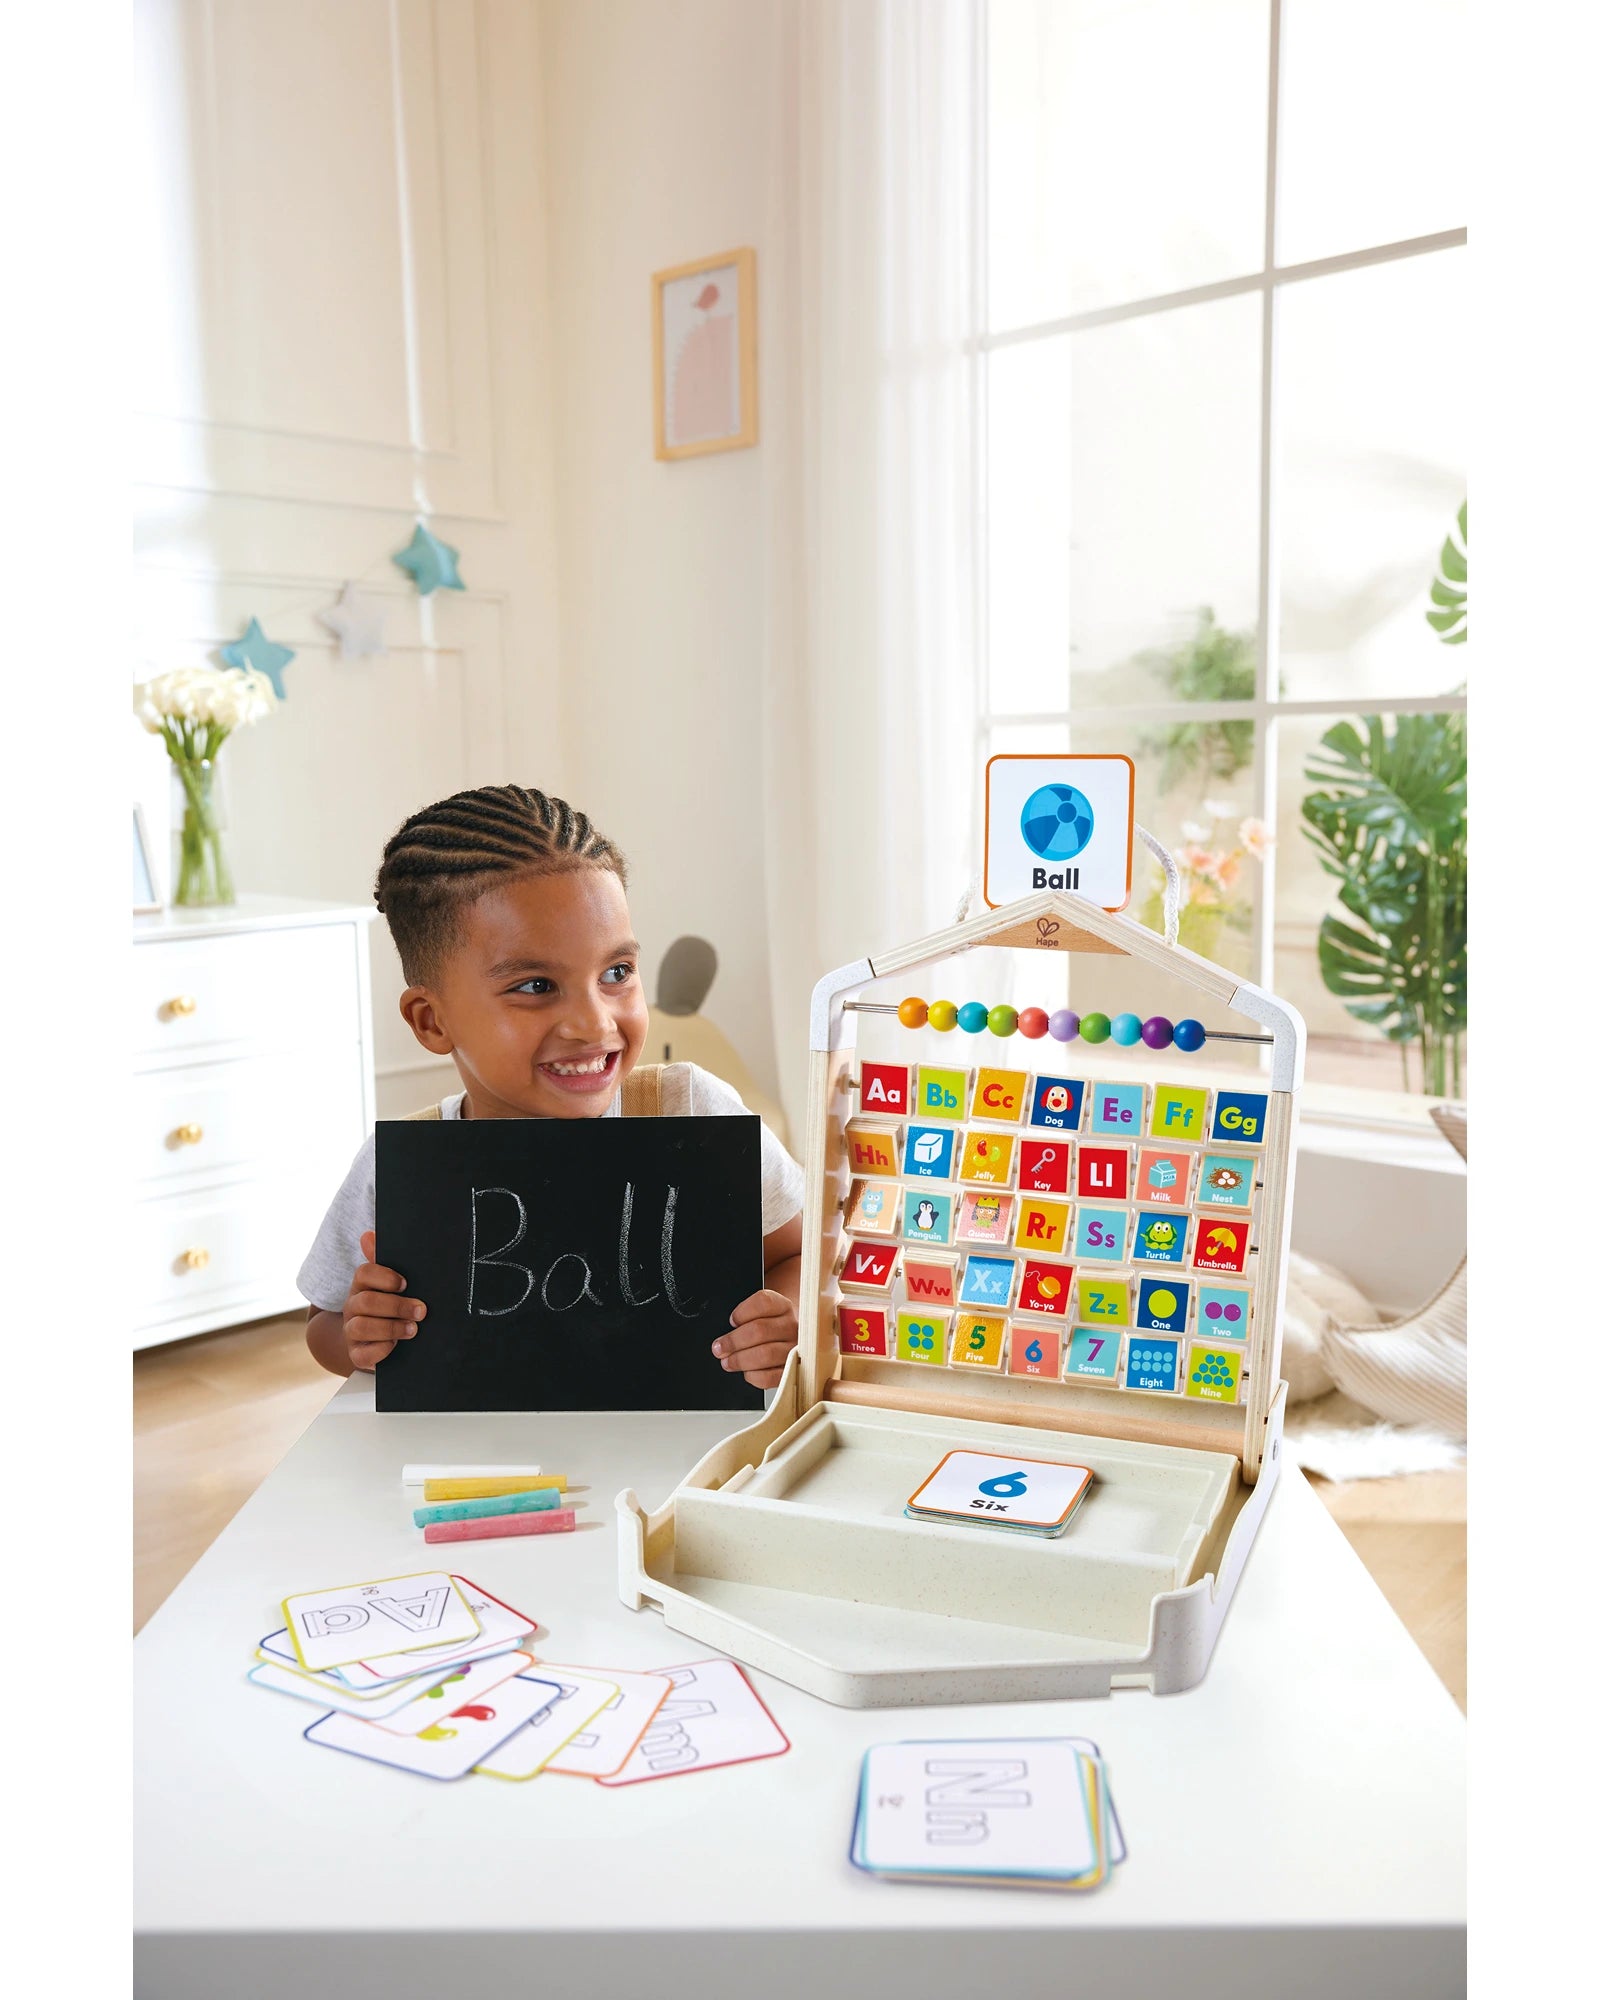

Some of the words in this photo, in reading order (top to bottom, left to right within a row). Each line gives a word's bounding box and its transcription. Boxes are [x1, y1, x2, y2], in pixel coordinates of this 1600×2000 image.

[1032, 868, 1079, 890] Ball
[1036, 938, 1059, 947] Hape
[867, 1078, 900, 1103] Aa
[926, 1082, 957, 1108] Bb
[982, 1083, 1014, 1109] Cc
[1103, 1097, 1133, 1123] Ee
[1164, 1101, 1194, 1127] Ff
[1045, 1116, 1064, 1127] Dog
[1219, 1106, 1257, 1136] Gg
[855, 1144, 888, 1166] Hh
[919, 1167, 932, 1176] Ice
[973, 1170, 995, 1182] Jelly
[1034, 1181, 1051, 1191] Key
[1150, 1191, 1171, 1202] Milk
[1212, 1193, 1233, 1204] Nest
[1026, 1211, 1057, 1239] Rr
[908, 1229, 942, 1241] Penguin
[967, 1229, 996, 1240] Queen
[1087, 1221, 1115, 1248] Ss
[467, 1181, 704, 1318] Ball
[1145, 1250, 1171, 1260] Turtle
[855, 1253, 885, 1276] Vv
[1197, 1258, 1237, 1271] Umbrella
[908, 1276, 951, 1297] Ww
[970, 1269, 1003, 1294] Xx
[1029, 1299, 1055, 1311] Yo-yo
[1088, 1293, 1118, 1315] Zz
[854, 1319, 870, 1341] 3
[1151, 1319, 1171, 1330] One
[1212, 1326, 1231, 1337] Two
[968, 1326, 987, 1350] 5
[851, 1343, 875, 1353] Three
[910, 1351, 930, 1361] Four
[1025, 1339, 1043, 1362] 6
[1087, 1338, 1105, 1361] 7
[965, 1352, 984, 1362] Five
[1026, 1365, 1040, 1374] Six
[1078, 1363, 1105, 1374] Seven
[1139, 1377, 1163, 1388] Eight
[1200, 1387, 1222, 1398] Nine
[978, 1471, 1028, 1498] 6
[969, 1499, 1009, 1512] Six
[302, 1586, 450, 1638] Aa
[925, 1759, 1032, 1845] Nn
